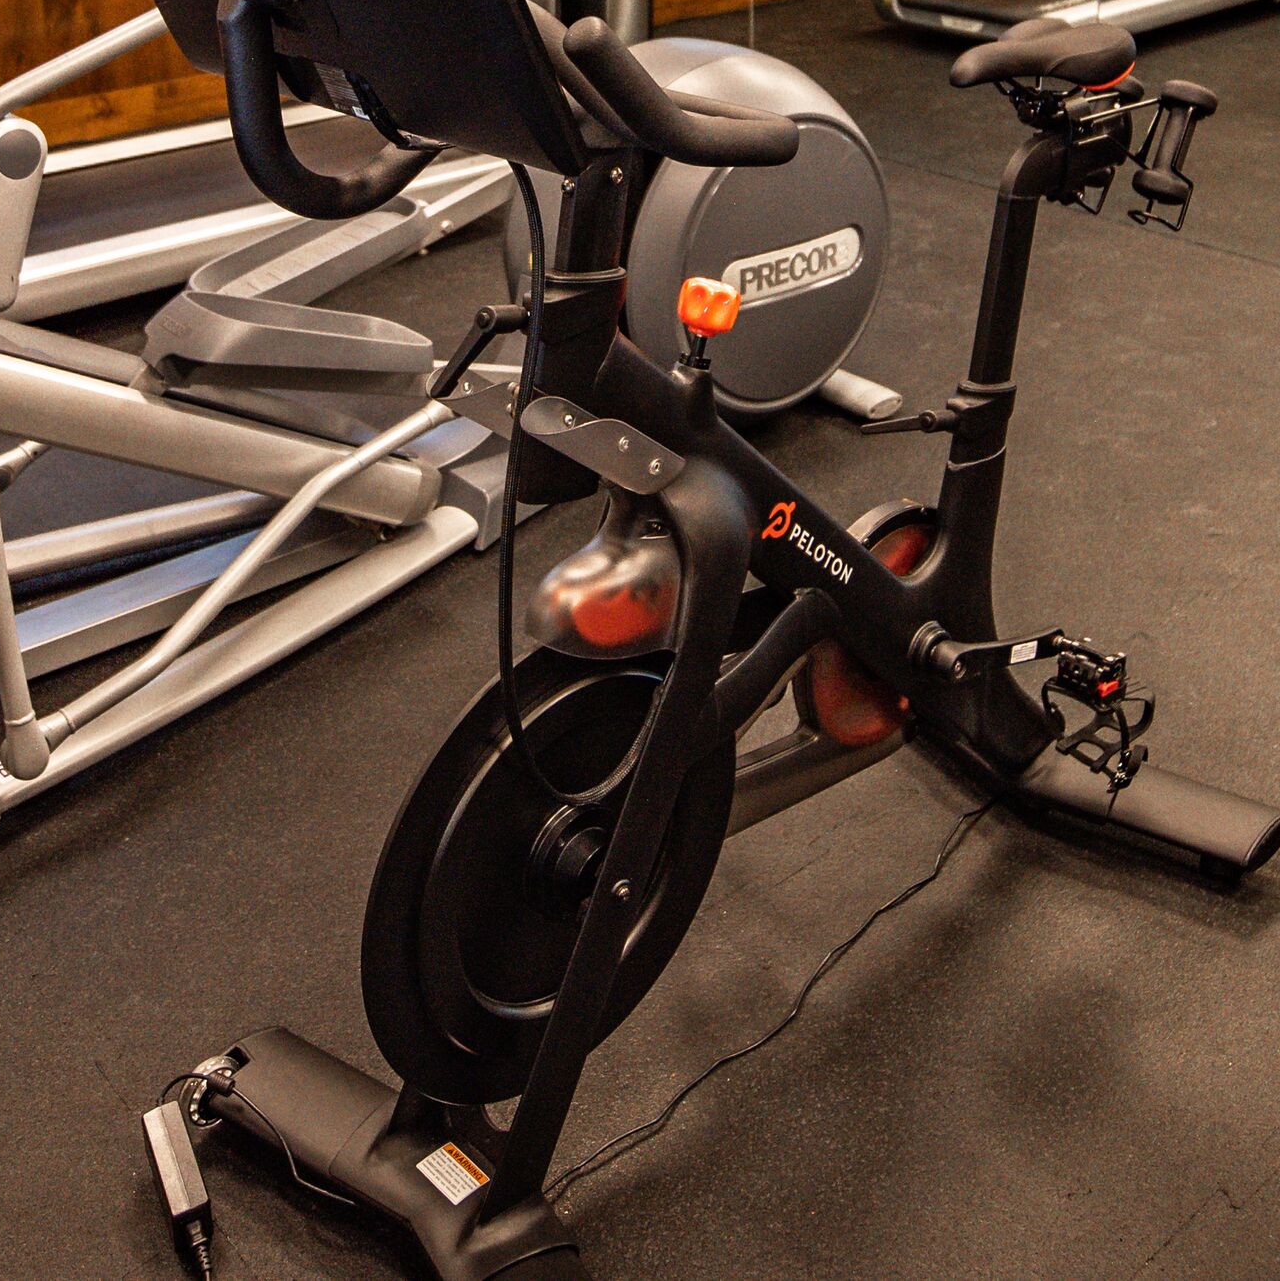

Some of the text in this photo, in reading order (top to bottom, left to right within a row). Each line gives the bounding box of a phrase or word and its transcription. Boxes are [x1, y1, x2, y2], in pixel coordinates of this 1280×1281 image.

[740, 243, 838, 295] PRECOR
[789, 523, 853, 585] PELOTON
[453, 1150, 483, 1181] WARNING
